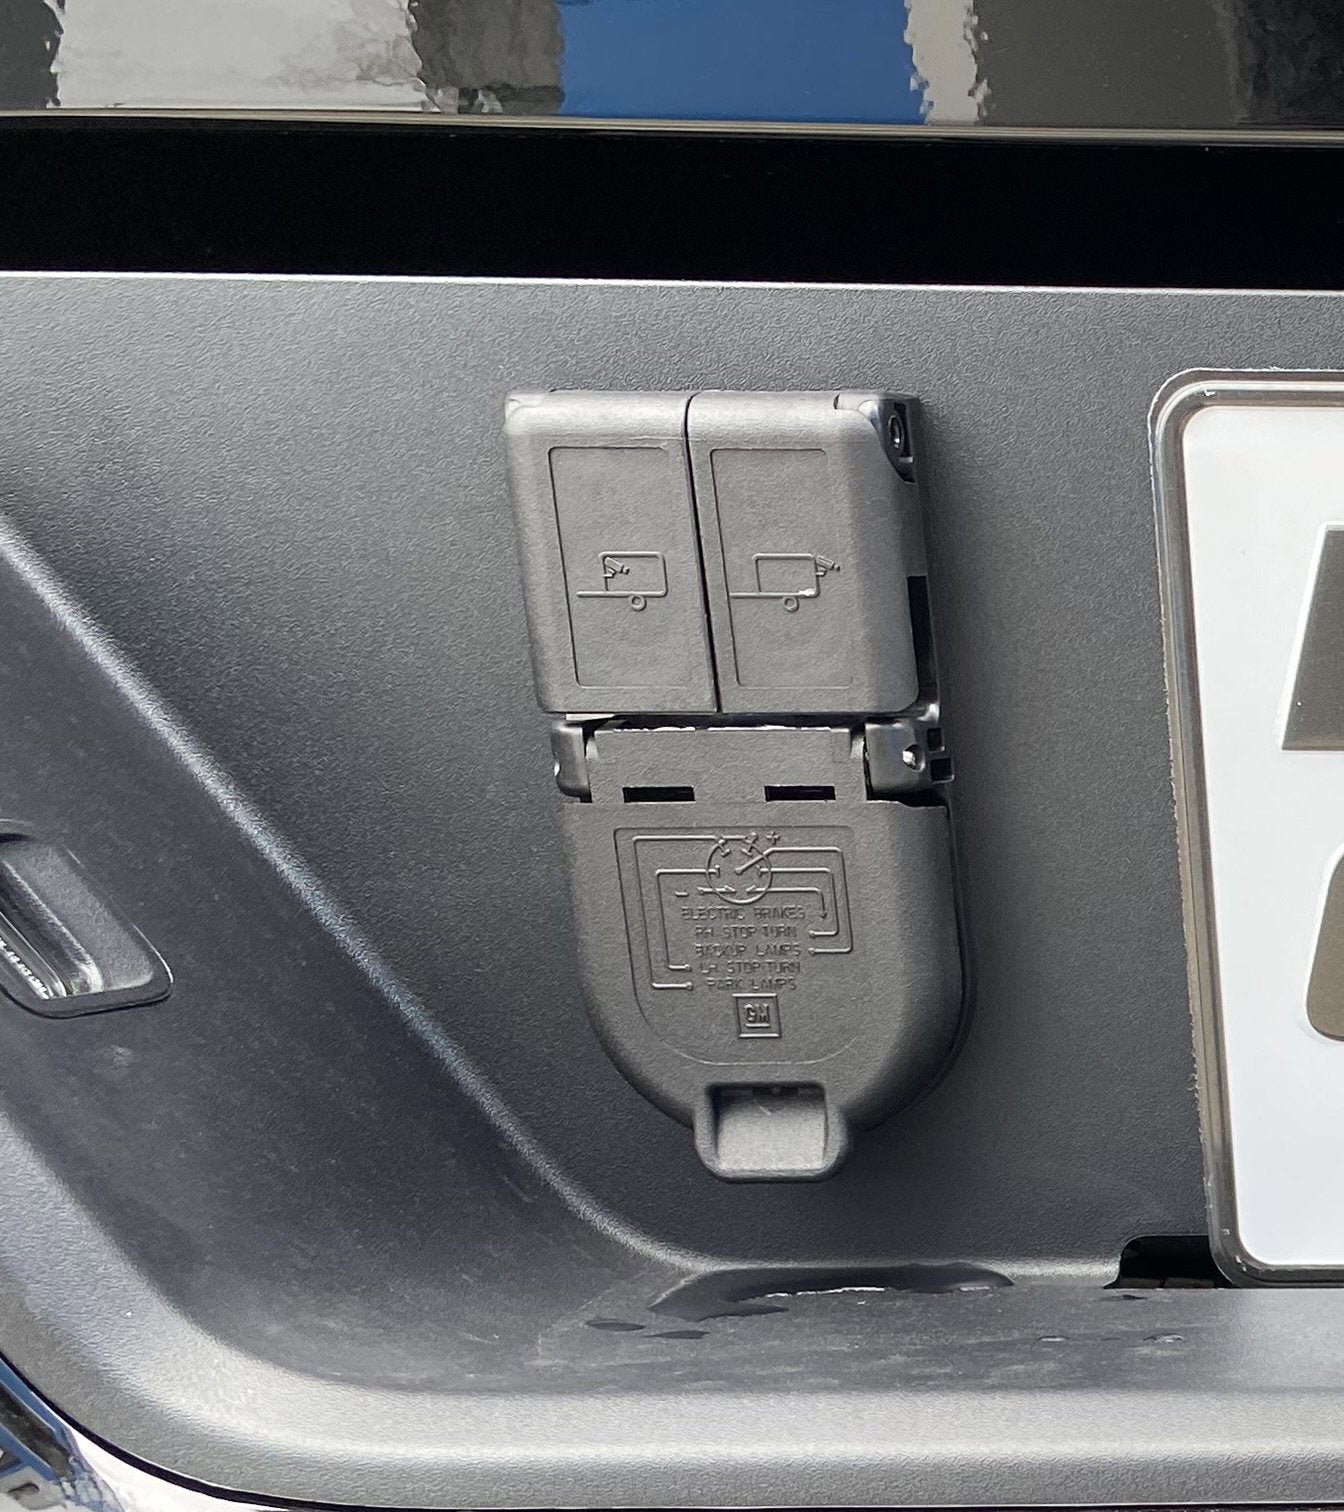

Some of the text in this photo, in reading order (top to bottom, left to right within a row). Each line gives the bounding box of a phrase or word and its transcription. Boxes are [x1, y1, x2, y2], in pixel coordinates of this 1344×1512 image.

[753, 904, 806, 920] BRAKES
[723, 924, 757, 938] STOP
[744, 1002, 771, 1024] GM
